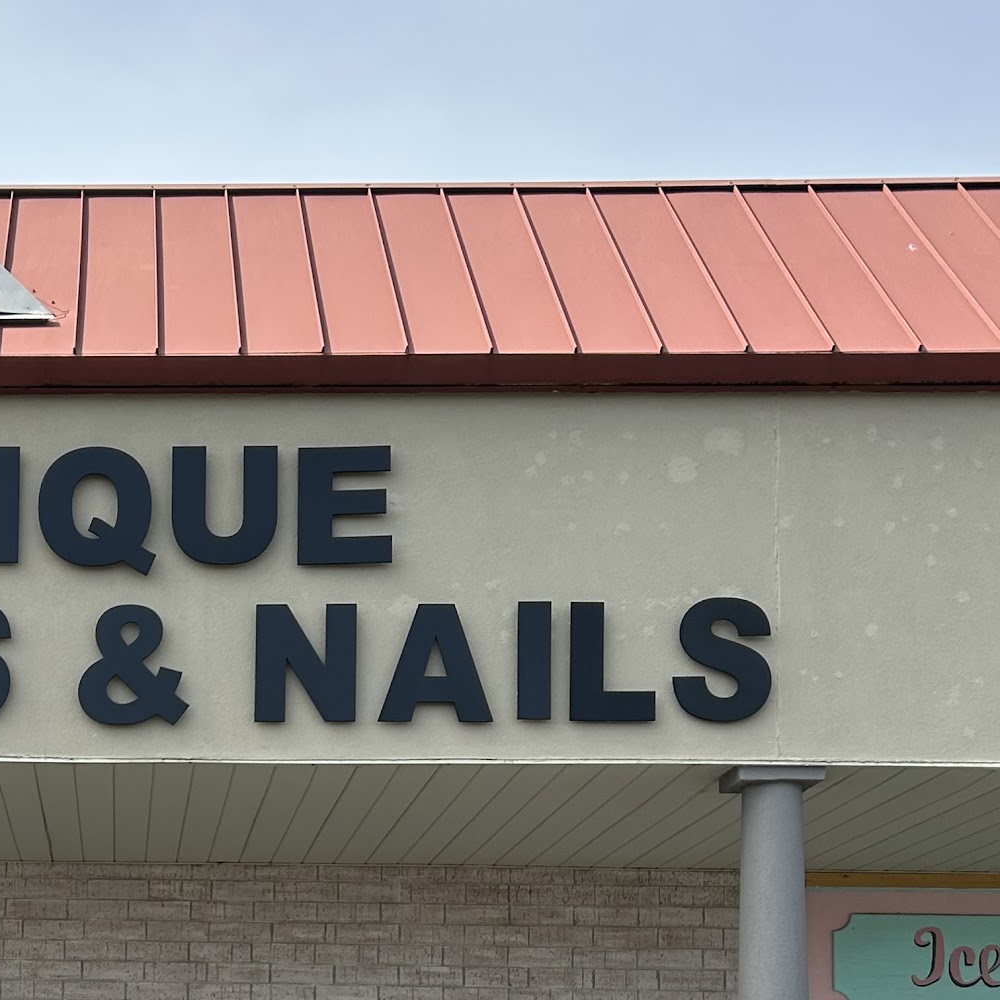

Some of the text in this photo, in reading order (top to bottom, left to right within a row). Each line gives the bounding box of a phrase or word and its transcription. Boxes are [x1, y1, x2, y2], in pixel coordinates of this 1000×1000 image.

[78, 604, 189, 729] &
[254, 597, 772, 727] NAILS
[911, 926, 1000, 988] Ice
